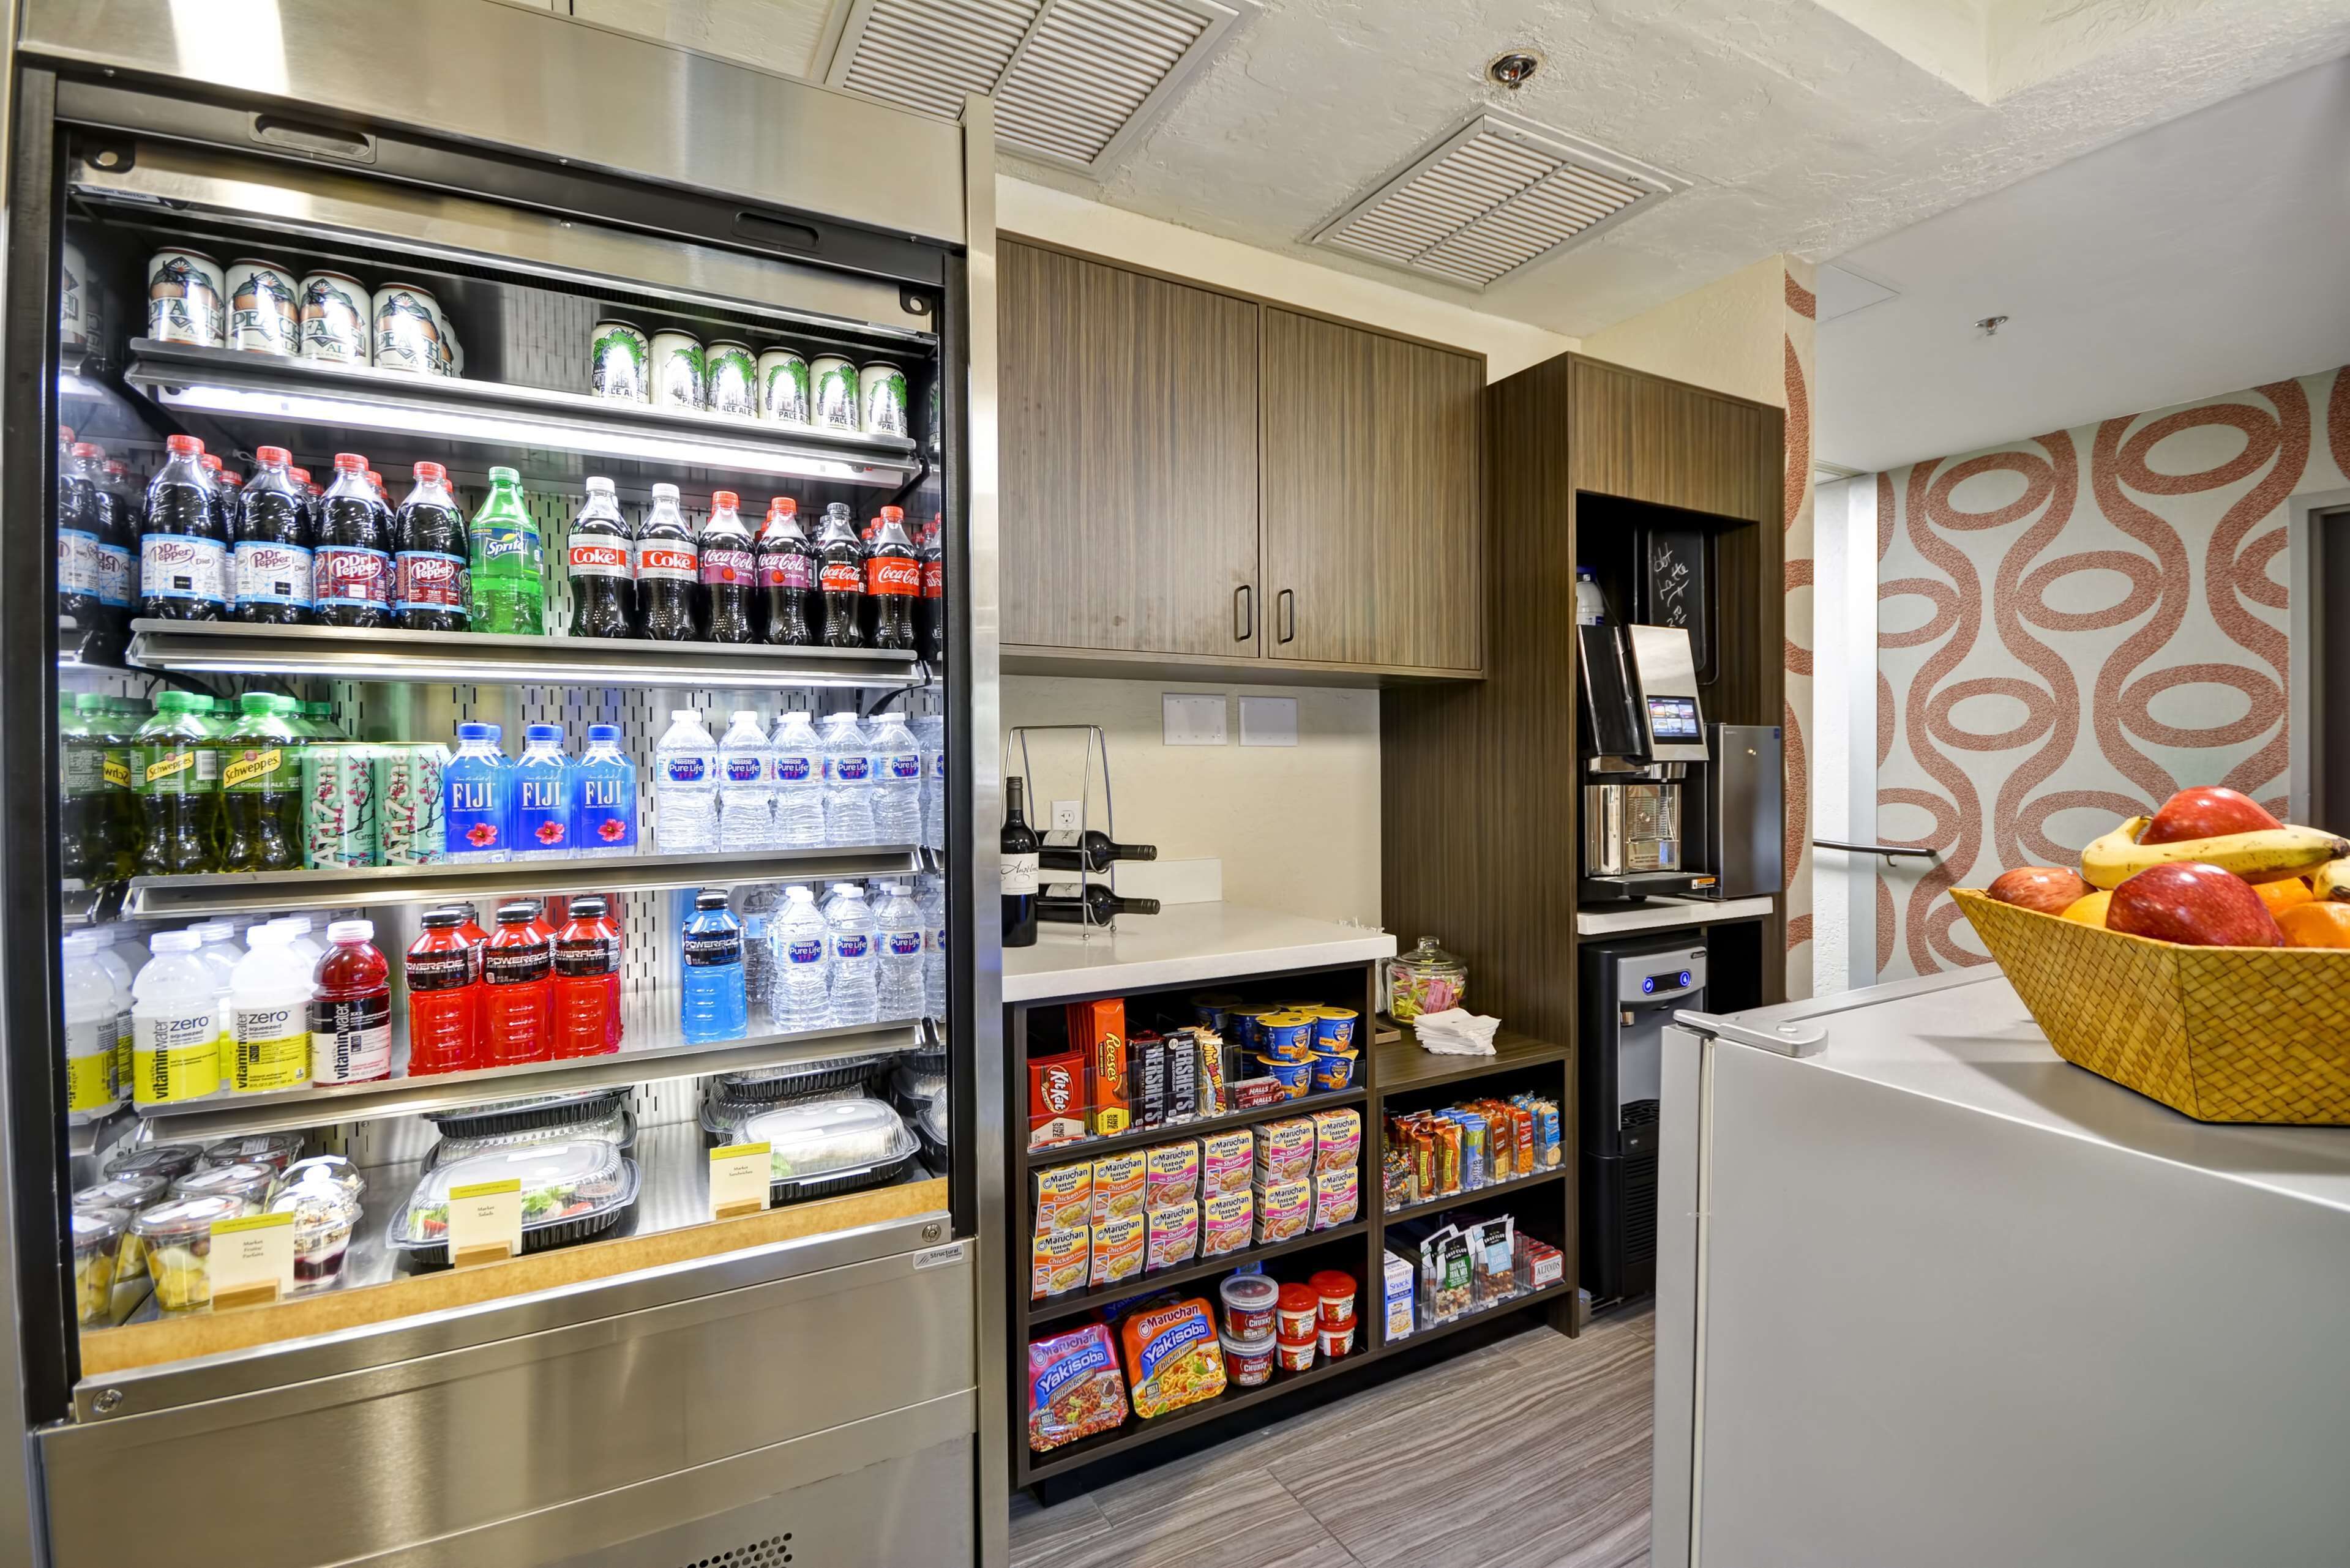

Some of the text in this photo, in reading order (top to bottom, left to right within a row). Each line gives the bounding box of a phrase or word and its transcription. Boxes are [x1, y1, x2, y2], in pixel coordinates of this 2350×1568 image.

[779, 411, 797, 420] PALE
[829, 416, 848, 425] PALE
[153, 545, 192, 562] Pepper
[486, 539, 525, 556] Sprite
[254, 551, 291, 568] Pepper
[264, 550, 280, 559] Dr
[350, 554, 369, 566] Dr
[574, 548, 616, 564] Coke
[649, 551, 690, 568] Coke
[704, 550, 754, 570] Coca-Cola
[335, 556, 378, 578] Pepper
[425, 560, 442, 569] Dr
[758, 553, 804, 571] Coca-Cola
[416, 562, 452, 580] Pepper
[736, 570, 753, 579] cherry
[820, 566, 861, 581] Coca-Cola
[878, 566, 919, 586] Coca-Cola
[225, 756, 279, 783] Schweppes
[689, 764, 704, 774] Life
[746, 764, 760, 774] Life
[795, 764, 809, 773] Life
[856, 764, 867, 773] Life
[452, 783, 493, 808] FIJI
[522, 782, 561, 807] FIJI
[585, 780, 622, 805] FIJI
[685, 938, 738, 949] POWERADE
[854, 941, 867, 950] Life
[908, 938, 920, 948] Life
[808, 946, 821, 956] Life
[487, 951, 548, 965] POWERADE
[170, 1016, 209, 1031] zero
[249, 1011, 288, 1024] zero
[170, 1029, 204, 1039] squeezed
[235, 1011, 247, 1088] vitaminwater
[153, 1020, 168, 1099] vitaminwater
[1175, 1040, 1194, 1111] HERSHEY'S
[1145, 1047, 1164, 1122] HERSHEY'S
[1248, 1086, 1268, 1096] HALLS
[1252, 1096, 1273, 1105] HALLS
[1327, 1119, 1356, 1130] Maruchan
[1279, 1127, 1310, 1139] Maruchan
[1215, 1137, 1249, 1148] Maruchan
[1333, 1140, 1352, 1150] Shrimp
[1158, 1149, 1194, 1162] Maruchan
[1286, 1146, 1305, 1157] Shrimp
[1106, 1158, 1142, 1173] Maruchan
[1161, 1159, 1186, 1168] Instant
[1223, 1156, 1244, 1167] Shrimp
[1110, 1170, 1131, 1178] Instant
[1164, 1164, 1183, 1173] Lunch
[1051, 1168, 1088, 1182] Maruchan
[1166, 1171, 1188, 1183] Shrimp
[1327, 1172, 1355, 1184] Maruchan
[1055, 1179, 1077, 1189] Instant
[1107, 1181, 1132, 1191] Chicken
[1053, 1192, 1078, 1202] Chicken
[1274, 1185, 1306, 1198] Maruchan
[1333, 1190, 1350, 1201] Shrimp
[1216, 1196, 1249, 1209] Maruchan
[1277, 1195, 1299, 1204] Instant
[1279, 1200, 1297, 1209] Lunch
[1159, 1206, 1194, 1220] Maruchan
[1218, 1206, 1241, 1215] Instant
[1221, 1212, 1239, 1220] Lunch
[1281, 1206, 1301, 1218] Shrimp
[1104, 1220, 1140, 1234] Maruchan
[1164, 1217, 1184, 1226] Instant
[1223, 1218, 1244, 1230] Shrimp
[1046, 1230, 1084, 1245] Maruchan
[1109, 1231, 1129, 1240] Instant
[1167, 1227, 1188, 1239] Shrimp
[1050, 1241, 1072, 1250] Instant
[1106, 1244, 1131, 1253] Chicken
[930, 1248, 959, 1258] Structural
[1048, 1254, 1074, 1264] Chicken
[1536, 1261, 1560, 1276] ALTOIDS
[1147, 1304, 1199, 1329] Maruchan
[1249, 1316, 1271, 1327] CHUNKY
[1042, 1332, 1096, 1357] Maruchan
[1145, 1323, 1206, 1366] Yakisoba
[1039, 1351, 1104, 1395] Yakisoba
[1244, 1362, 1267, 1372] CHUNKY
